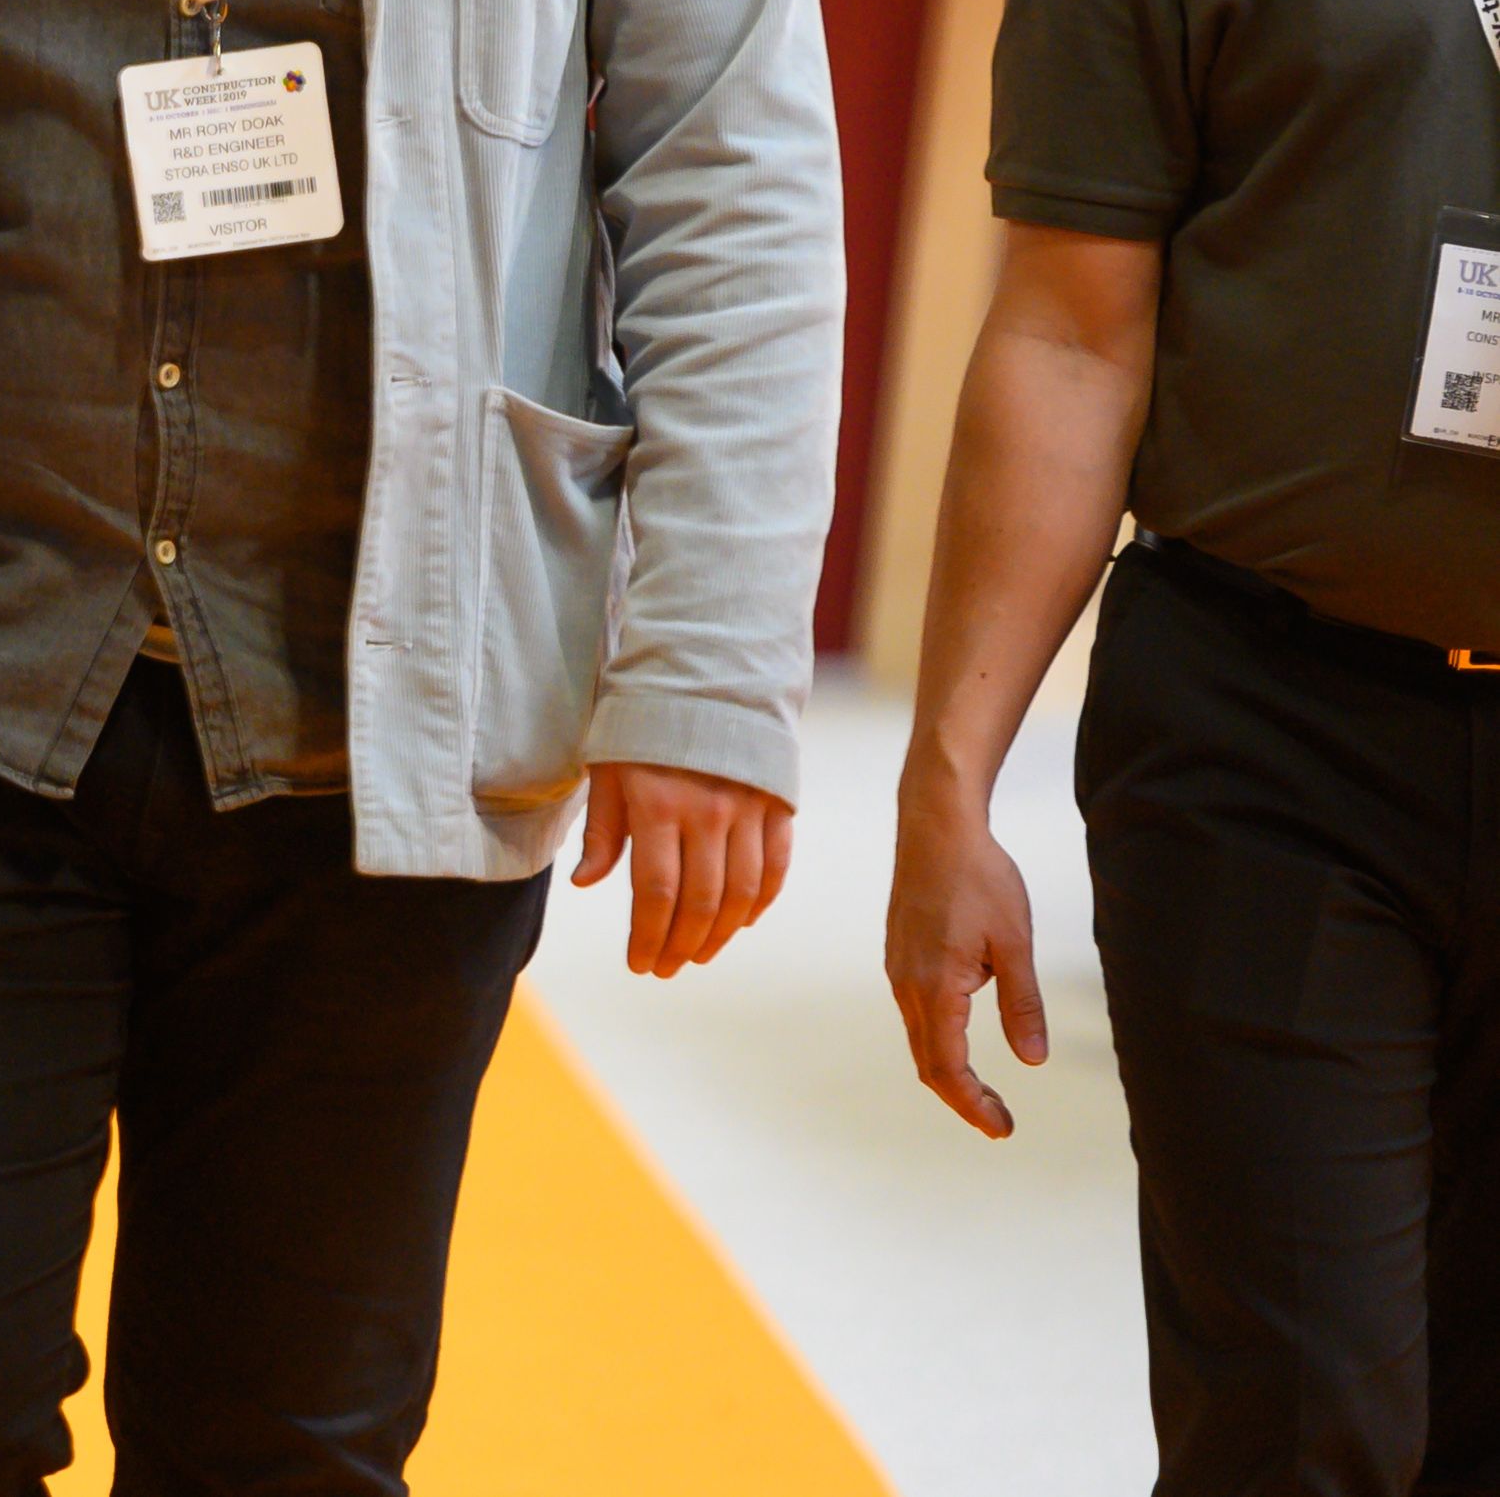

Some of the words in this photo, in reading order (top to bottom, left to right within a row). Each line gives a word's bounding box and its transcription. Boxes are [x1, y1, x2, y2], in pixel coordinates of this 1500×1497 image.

[144, 88, 182, 111] UK
[182, 75, 277, 95] CONSTRUCTION
[184, 93, 217, 106] WEEK
[169, 127, 192, 141] MR
[196, 121, 237, 137] RORY
[241, 115, 285, 132] DOAK
[173, 144, 204, 160] R&D
[208, 134, 286, 156] ENGINEER
[164, 164, 209, 181] STORA
[212, 159, 249, 175] ENSO
[252, 156, 271, 170] UK
[275, 152, 299, 167] LTD
[209, 218, 268, 236] VISITOR
[1459, 259, 1499, 287] UK
